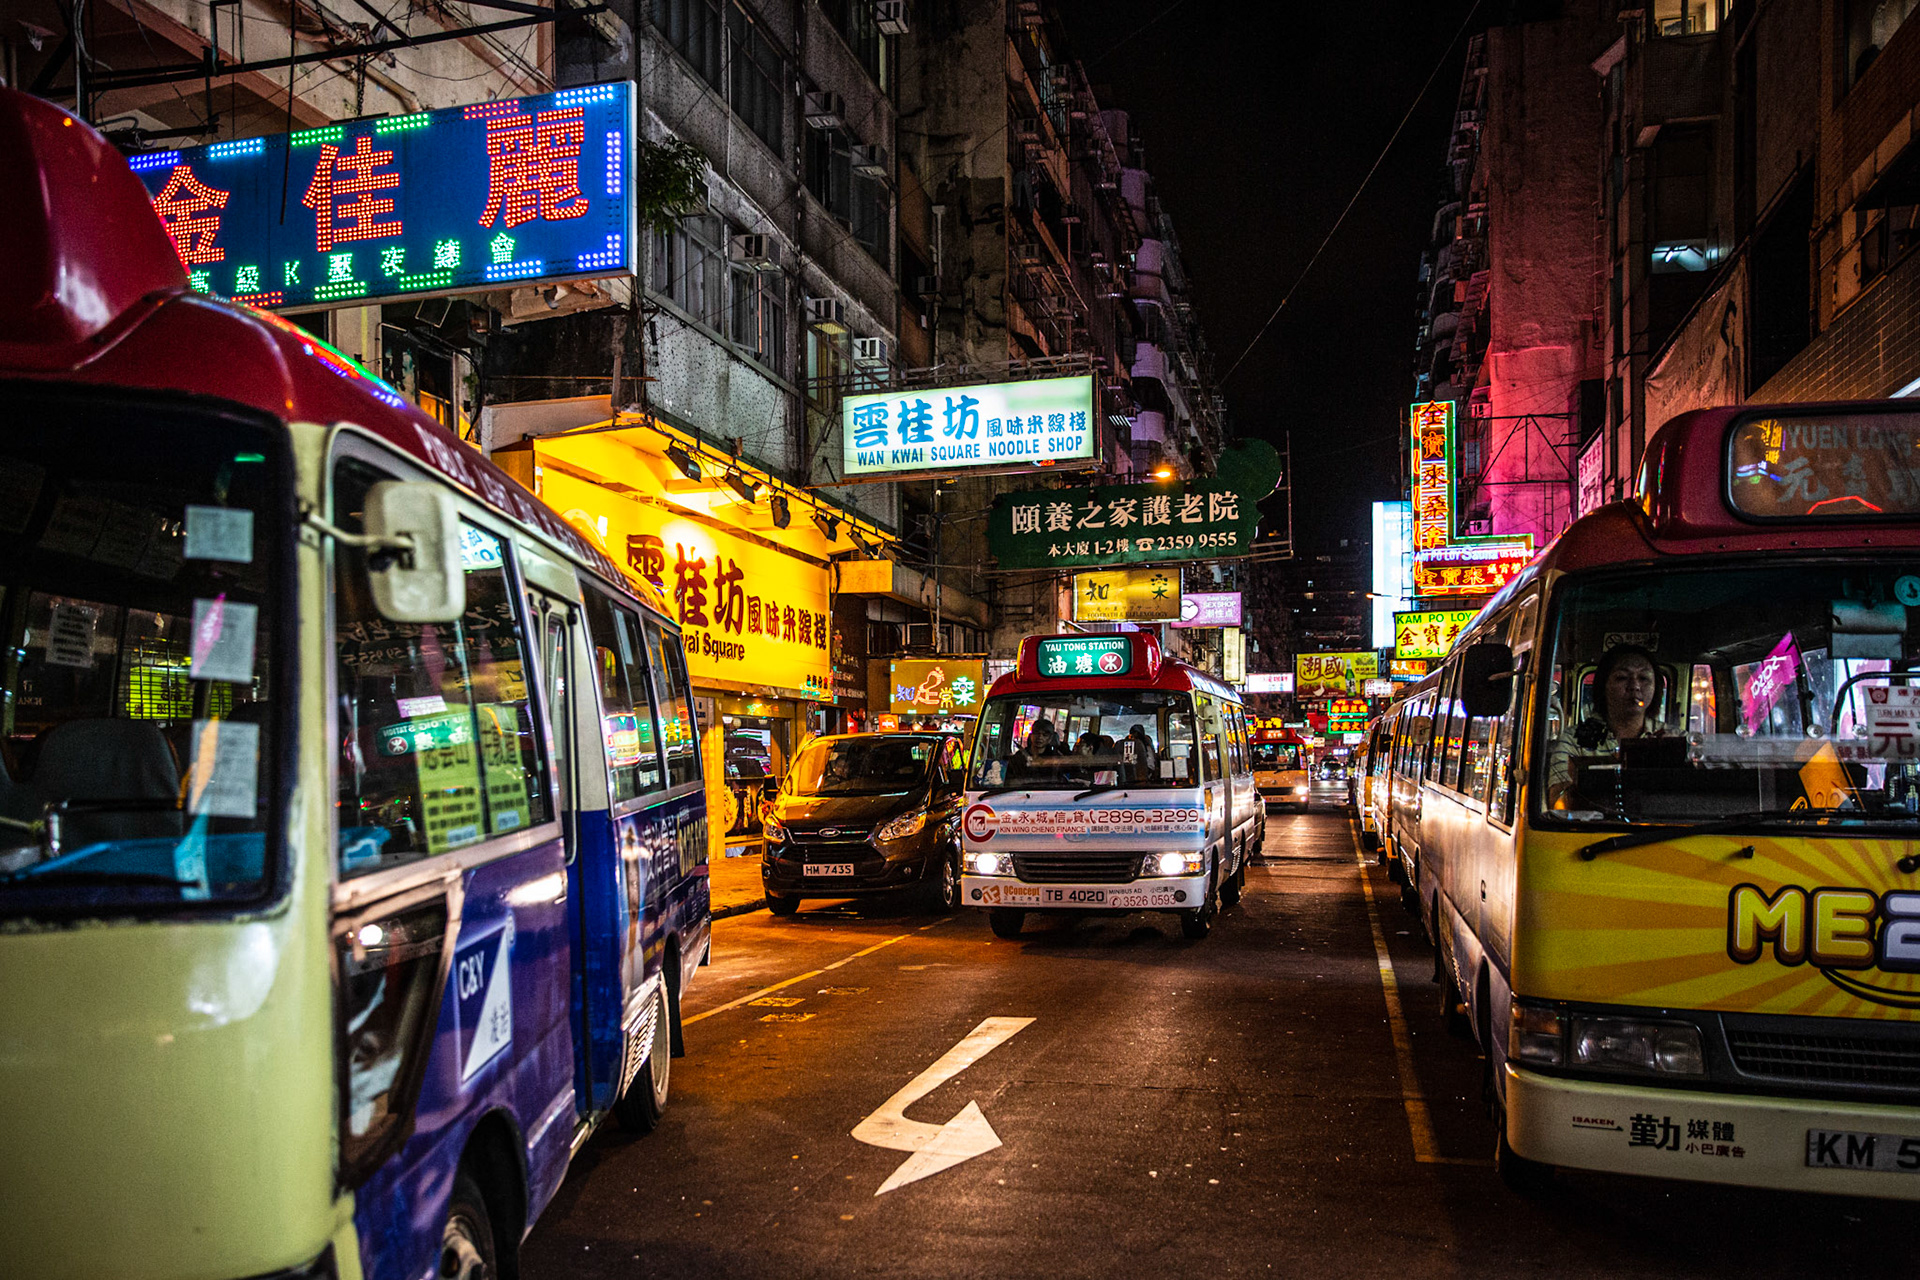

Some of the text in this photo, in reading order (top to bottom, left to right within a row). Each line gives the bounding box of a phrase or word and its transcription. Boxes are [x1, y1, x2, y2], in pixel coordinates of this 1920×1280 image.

[152, 107, 589, 265] 金佳麗
[853, 394, 1087, 448] 雲桂坊 風味米線棧
[1787, 425, 1848, 449] YUEN
[857, 435, 1083, 466] WAN KWAI SQUARE NOODLE SHOP
[1011, 490, 1239, 535] 頤養之家護老院
[1157, 534, 1194, 551] 2359
[1199, 531, 1237, 548] 9555
[1217, 600, 1236, 608] SHOP
[1396, 612, 1472, 625] KAM PO LOY
[703, 633, 745, 662] Square
[1045, 641, 1124, 652] YAU TONG STATION
[1001, 810, 1085, 824] 金永城信貸
[1098, 809, 1199, 824] 2896 3299
[805, 864, 852, 875] HM 7435
[1046, 889, 1063, 901] TB
[1069, 890, 1105, 902] 4020
[1124, 894, 1176, 907] 3526 0593
[458, 949, 485, 1001] C&Y
[1685, 1142, 1746, 1158] 小巴廣告
[1816, 1132, 1875, 1167] KM
